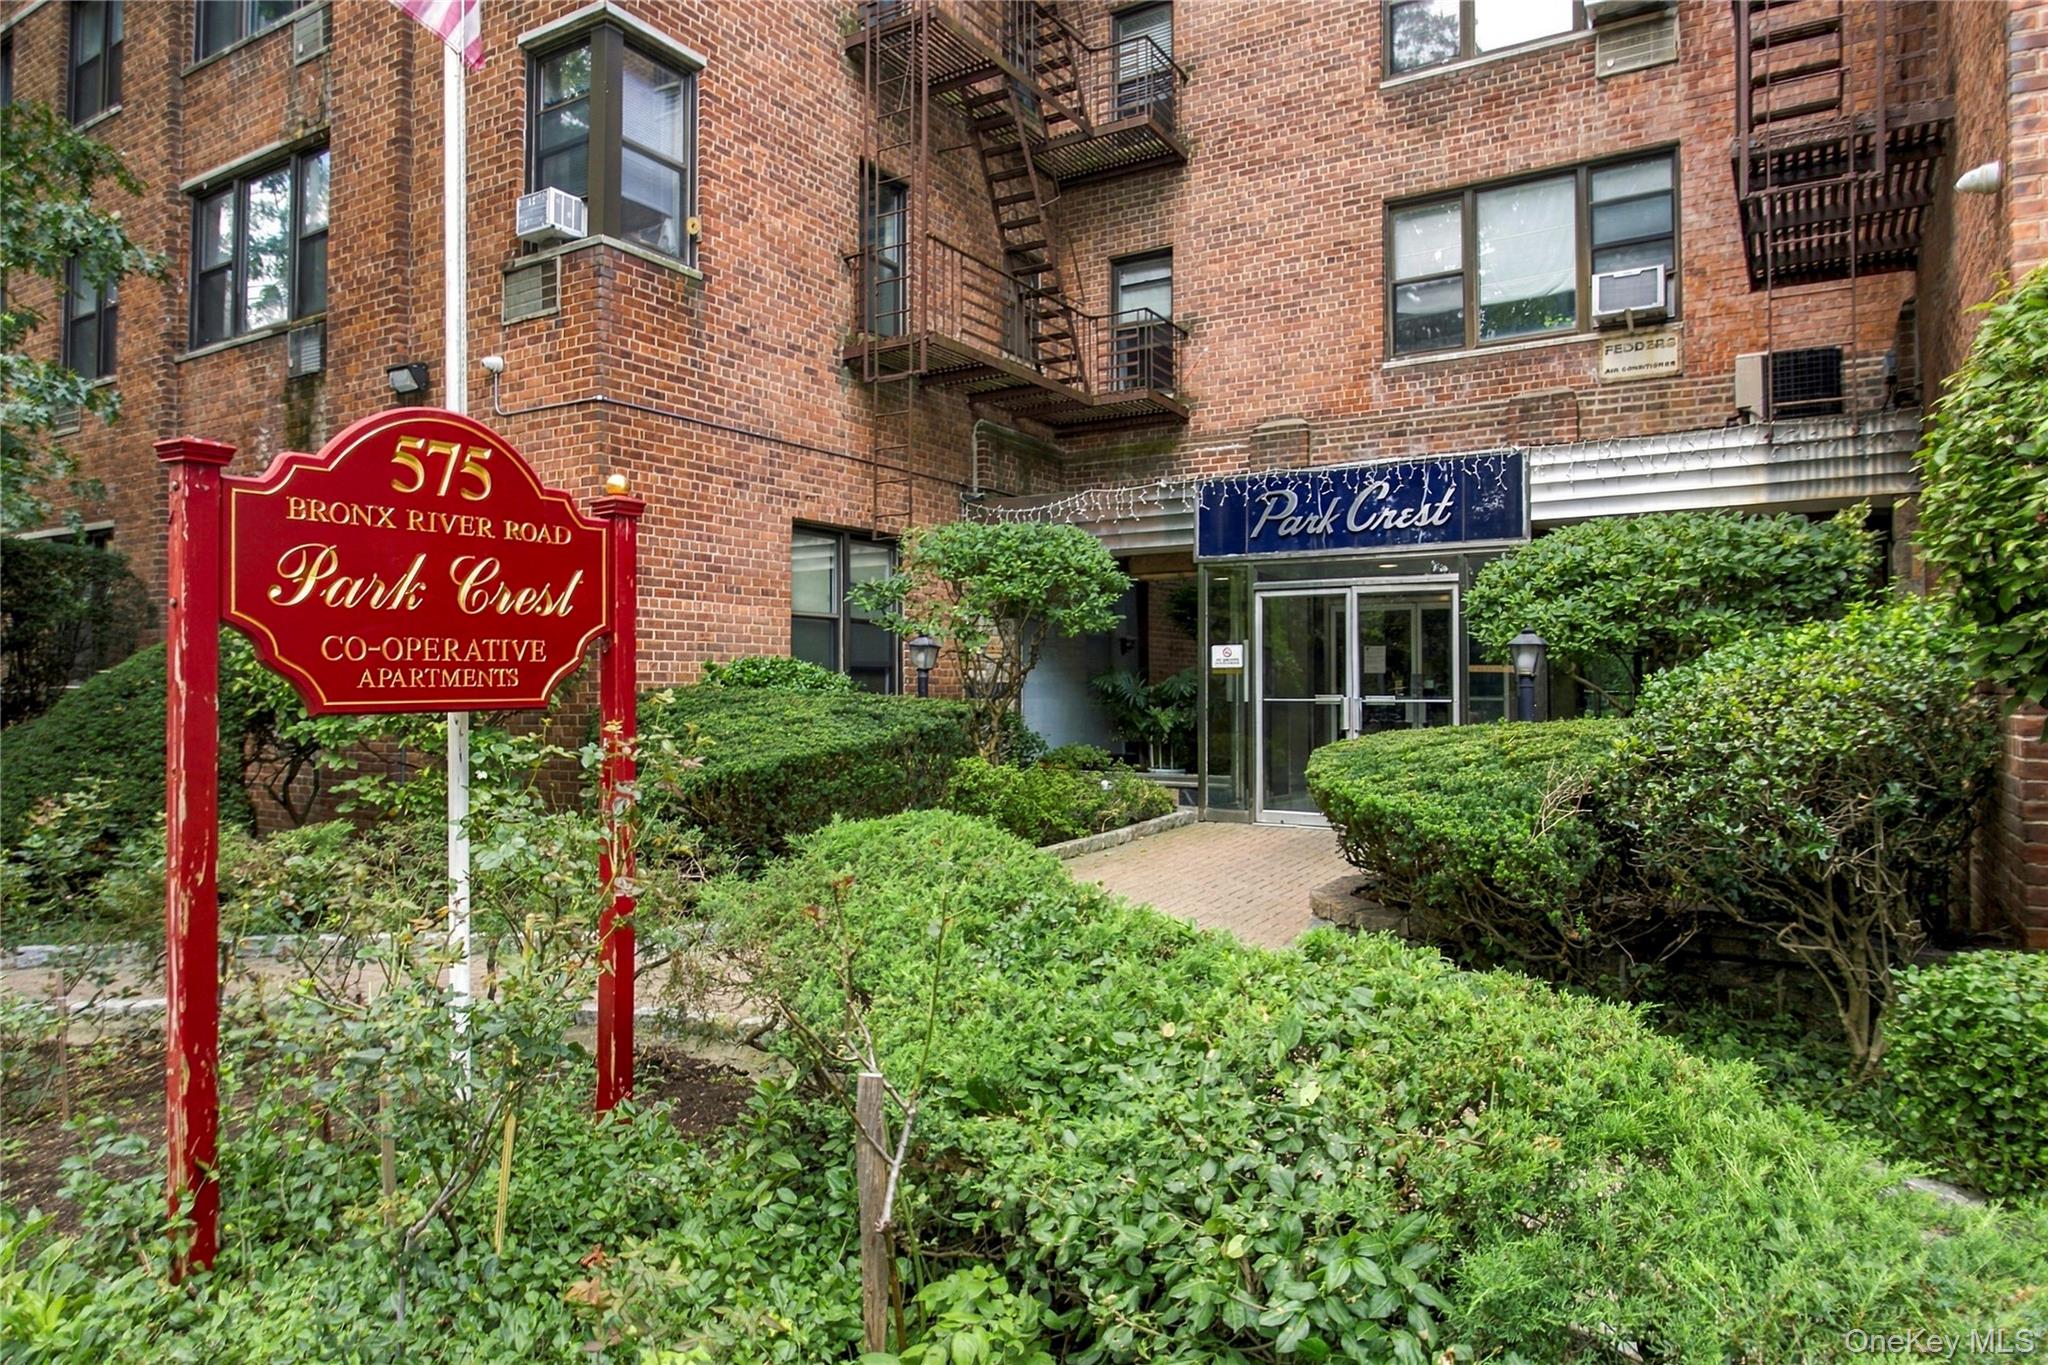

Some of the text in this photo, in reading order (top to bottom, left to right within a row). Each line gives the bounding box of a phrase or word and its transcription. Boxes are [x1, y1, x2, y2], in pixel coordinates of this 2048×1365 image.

[1604, 337, 1676, 356] FEDDERS
[390, 434, 493, 501] 575
[285, 496, 572, 545] BRONX RIVER ROAD
[1250, 480, 1456, 540] Park Crest
[267, 542, 584, 617] Park Crest
[321, 635, 547, 663] CO-OPERATIVE
[356, 668, 520, 689] APARTMENTS
